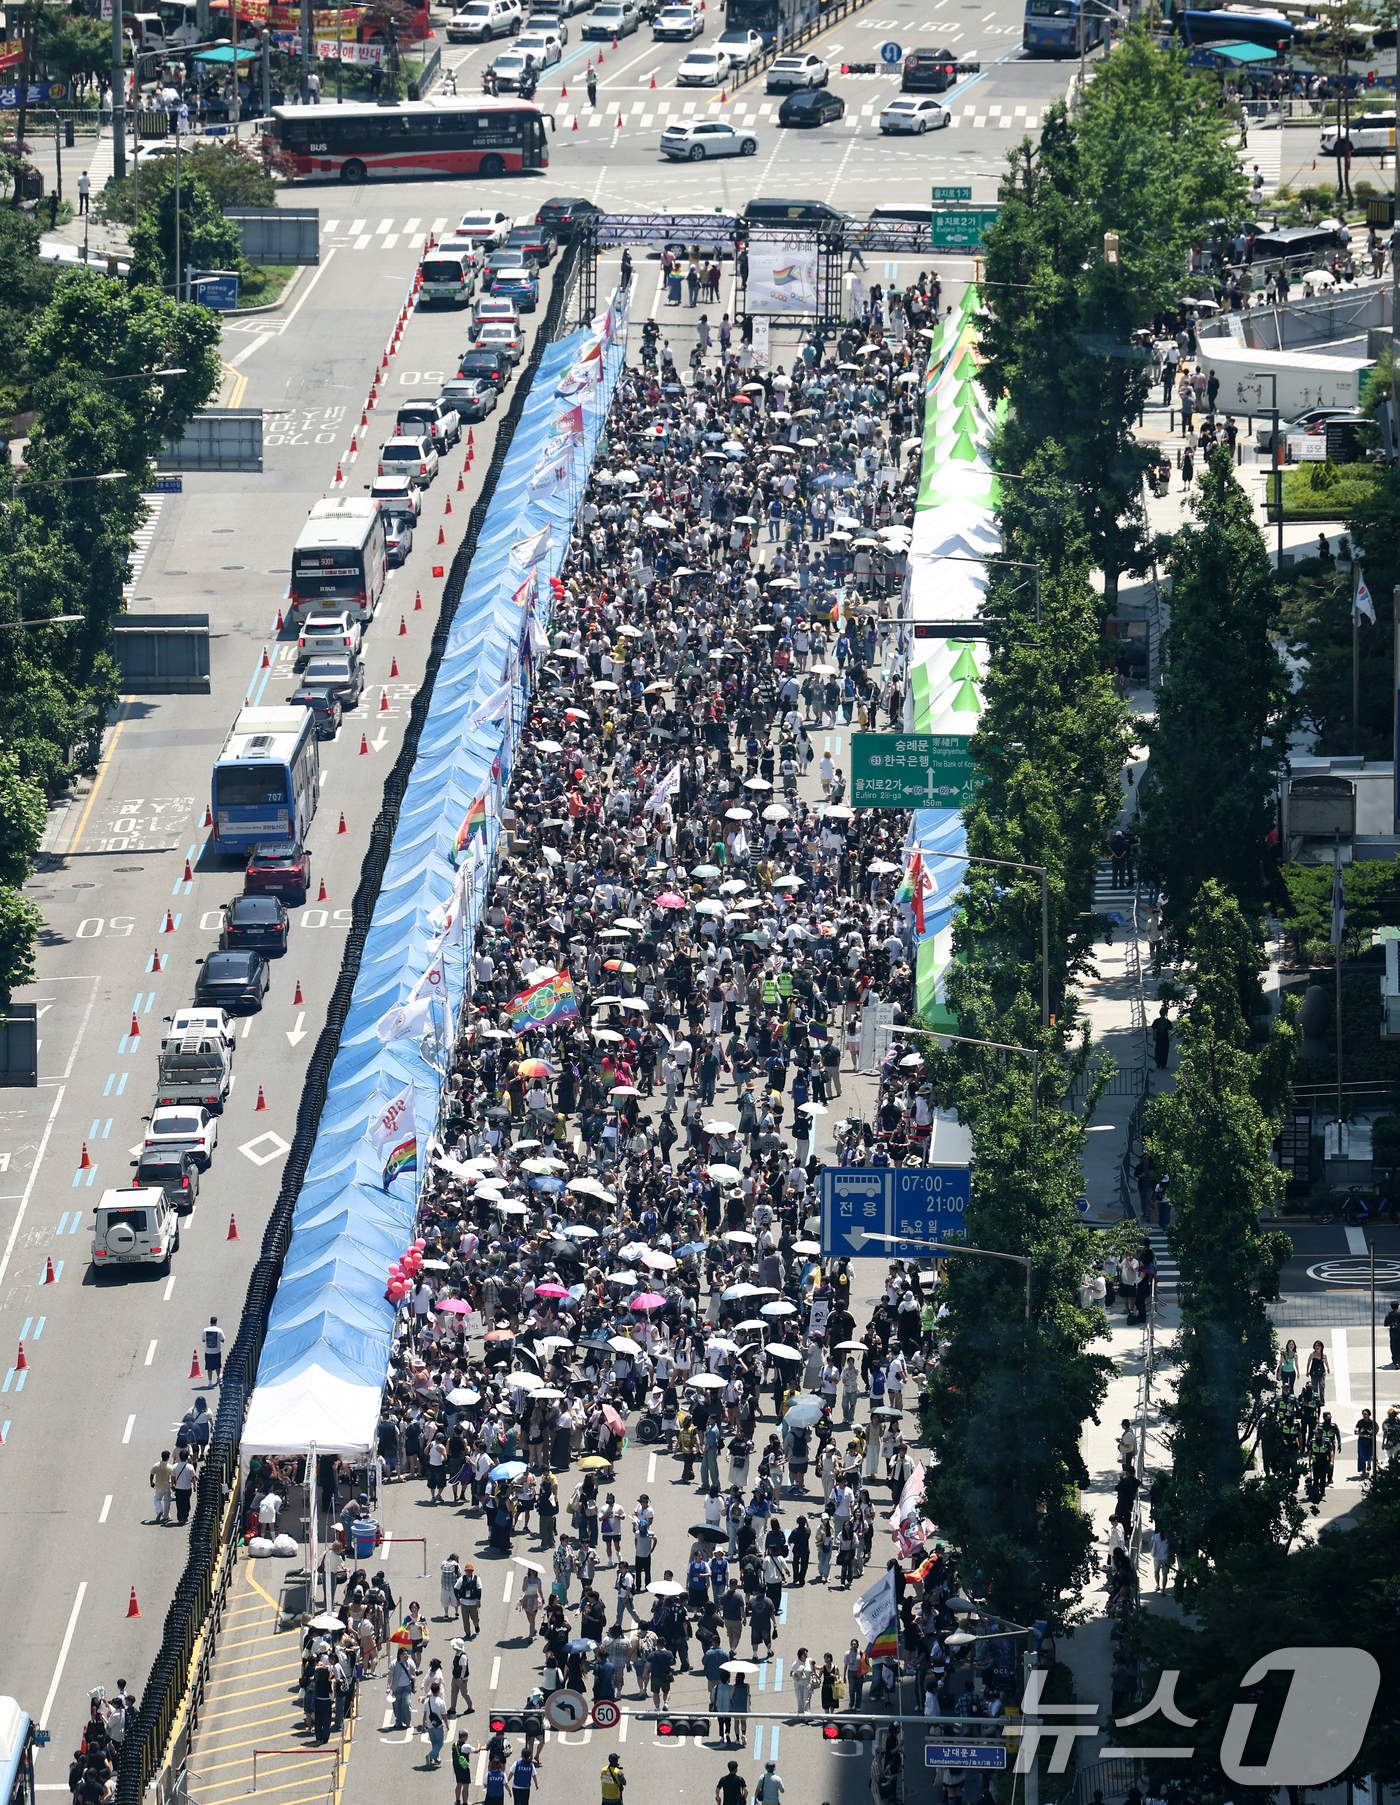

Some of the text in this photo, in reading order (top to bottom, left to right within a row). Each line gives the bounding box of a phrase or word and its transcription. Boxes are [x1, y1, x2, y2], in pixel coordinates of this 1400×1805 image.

[358, 47, 381, 60] 반대
[934, 188, 970, 198] 을지로1가
[936, 216, 976, 226] 을지로2가
[895, 740, 929, 752] 숭례문
[932, 747, 967, 756] Sungnyemun
[884, 754, 929, 768] 한국은행
[855, 778, 902, 791] 을지로2가
[268, 794, 282, 802] 707
[765, 1142, 774, 1150] 99
[902, 1176, 942, 1192] 07:00
[926, 1196, 964, 1212] 21:00
[597, 1708, 614, 1722] 50
[942, 1748, 978, 1757] 남대문로
